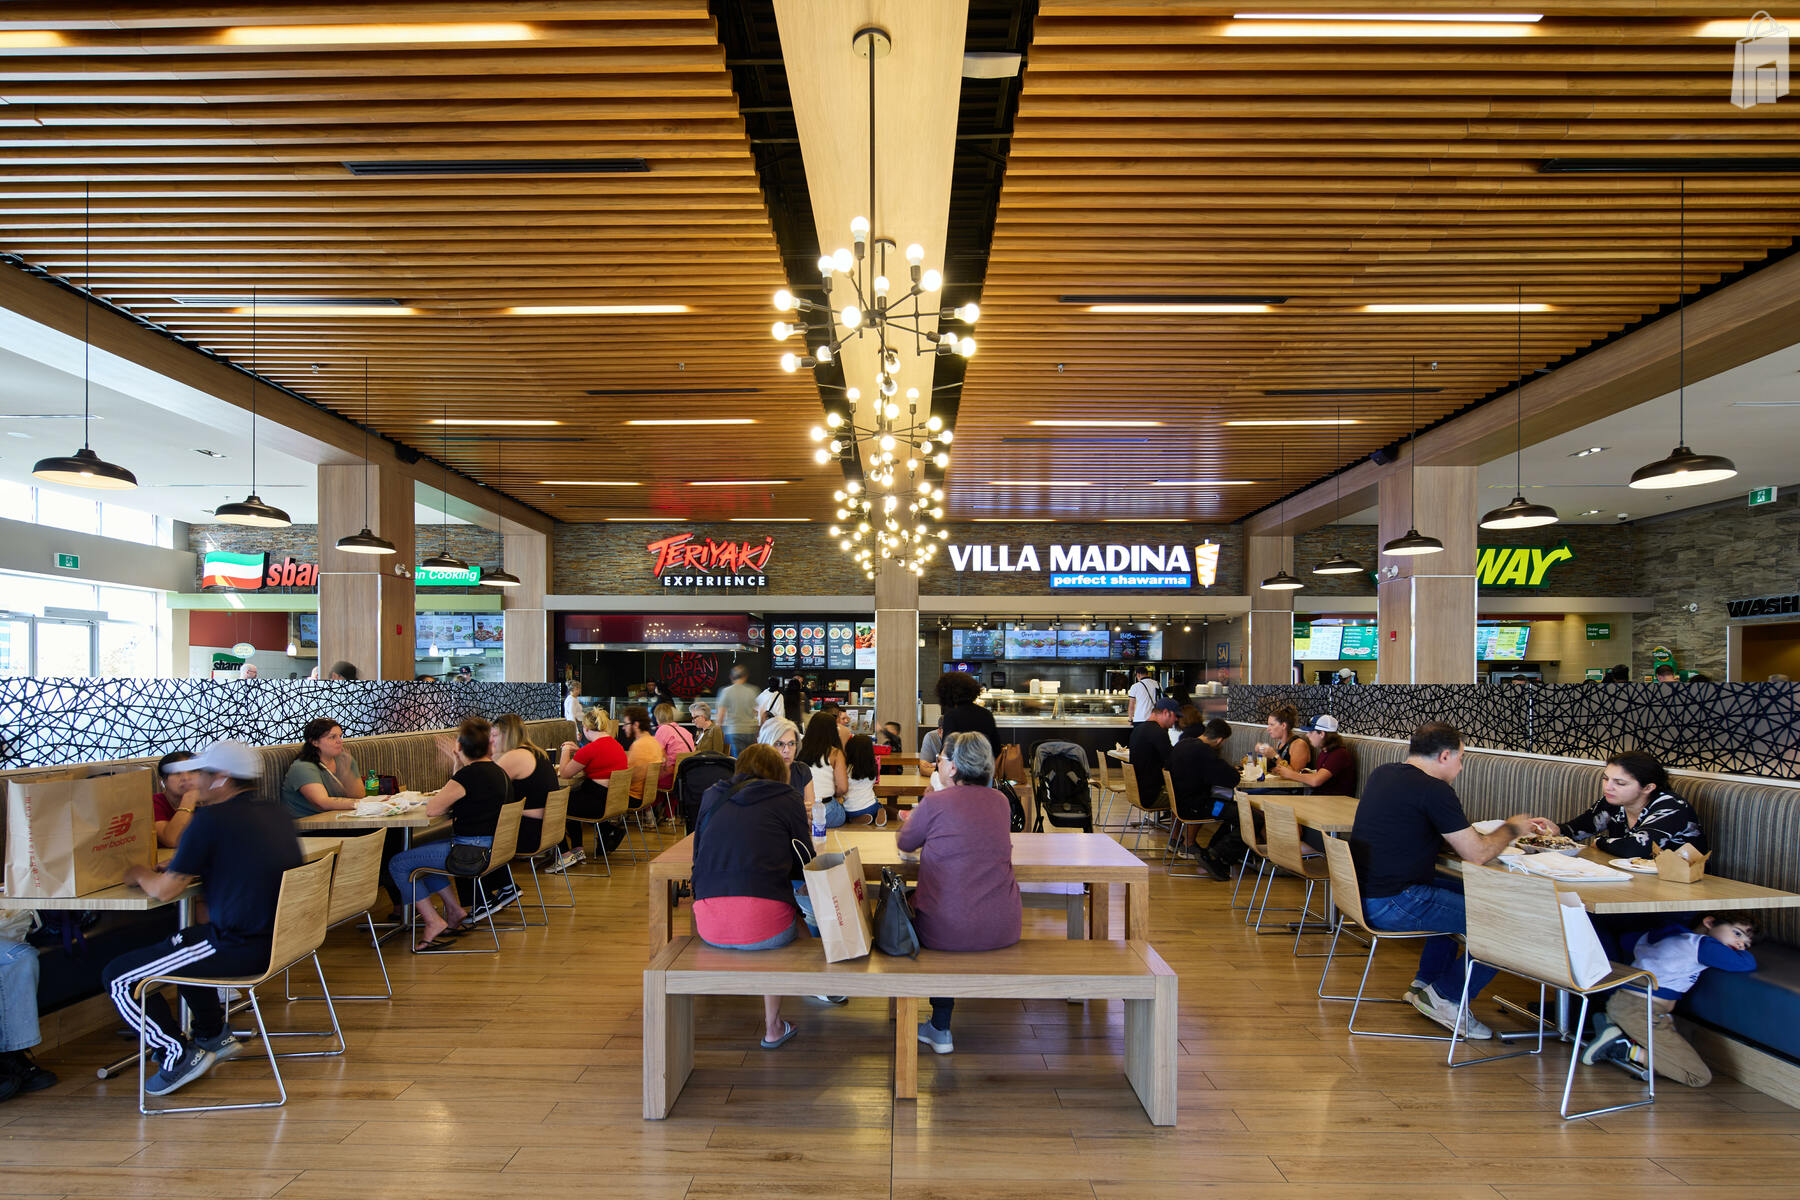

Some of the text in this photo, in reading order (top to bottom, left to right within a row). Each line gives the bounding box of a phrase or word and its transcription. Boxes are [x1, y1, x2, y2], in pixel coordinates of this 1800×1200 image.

[948, 545, 1191, 572] VILLA MADINA
[429, 570, 477, 582] Cooking
[664, 576, 766, 586] EXPERIENCE
[1053, 574, 1187, 586] perfect shawarma
[1727, 595, 1799, 617] WASH
[666, 656, 714, 679] JAPAN
